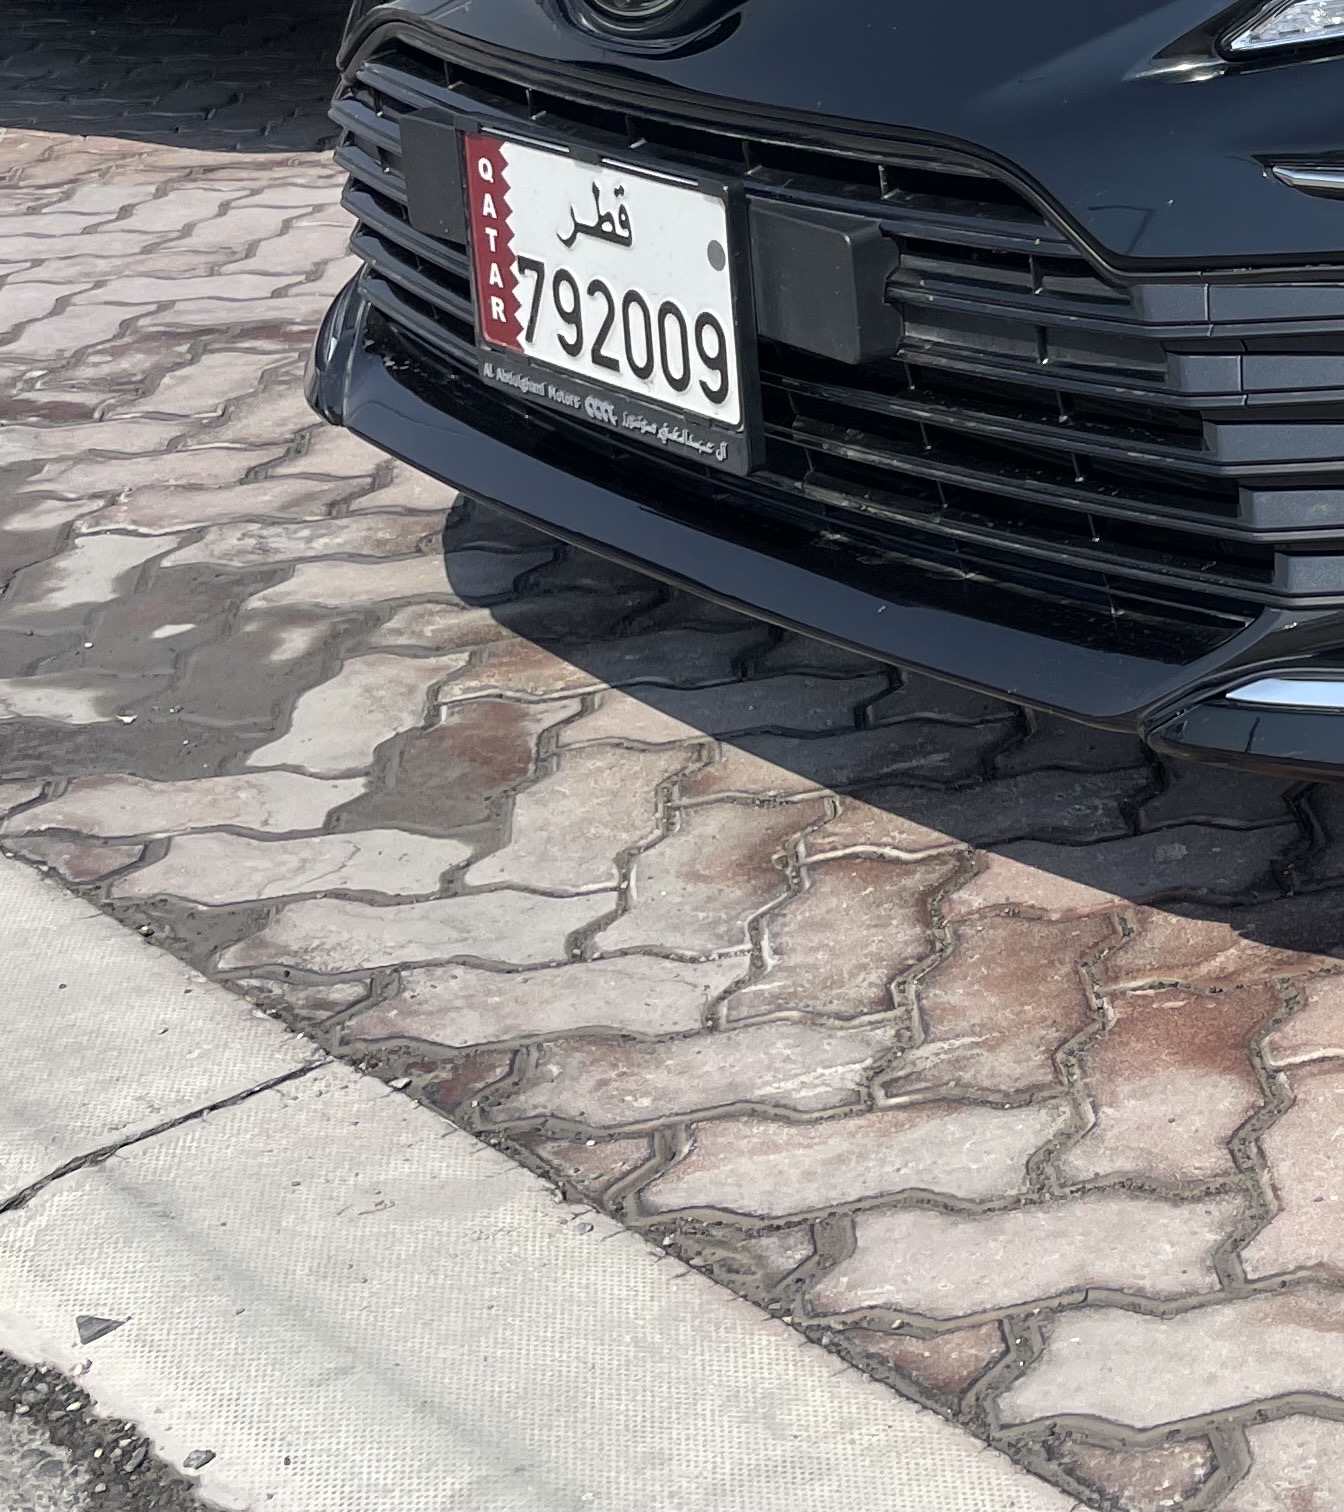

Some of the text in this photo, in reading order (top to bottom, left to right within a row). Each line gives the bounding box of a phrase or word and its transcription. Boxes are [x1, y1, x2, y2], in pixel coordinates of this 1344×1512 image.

[477, 156, 507, 323] QATAR
[556, 181, 633, 249] قطر
[517, 254, 730, 405] 792009
